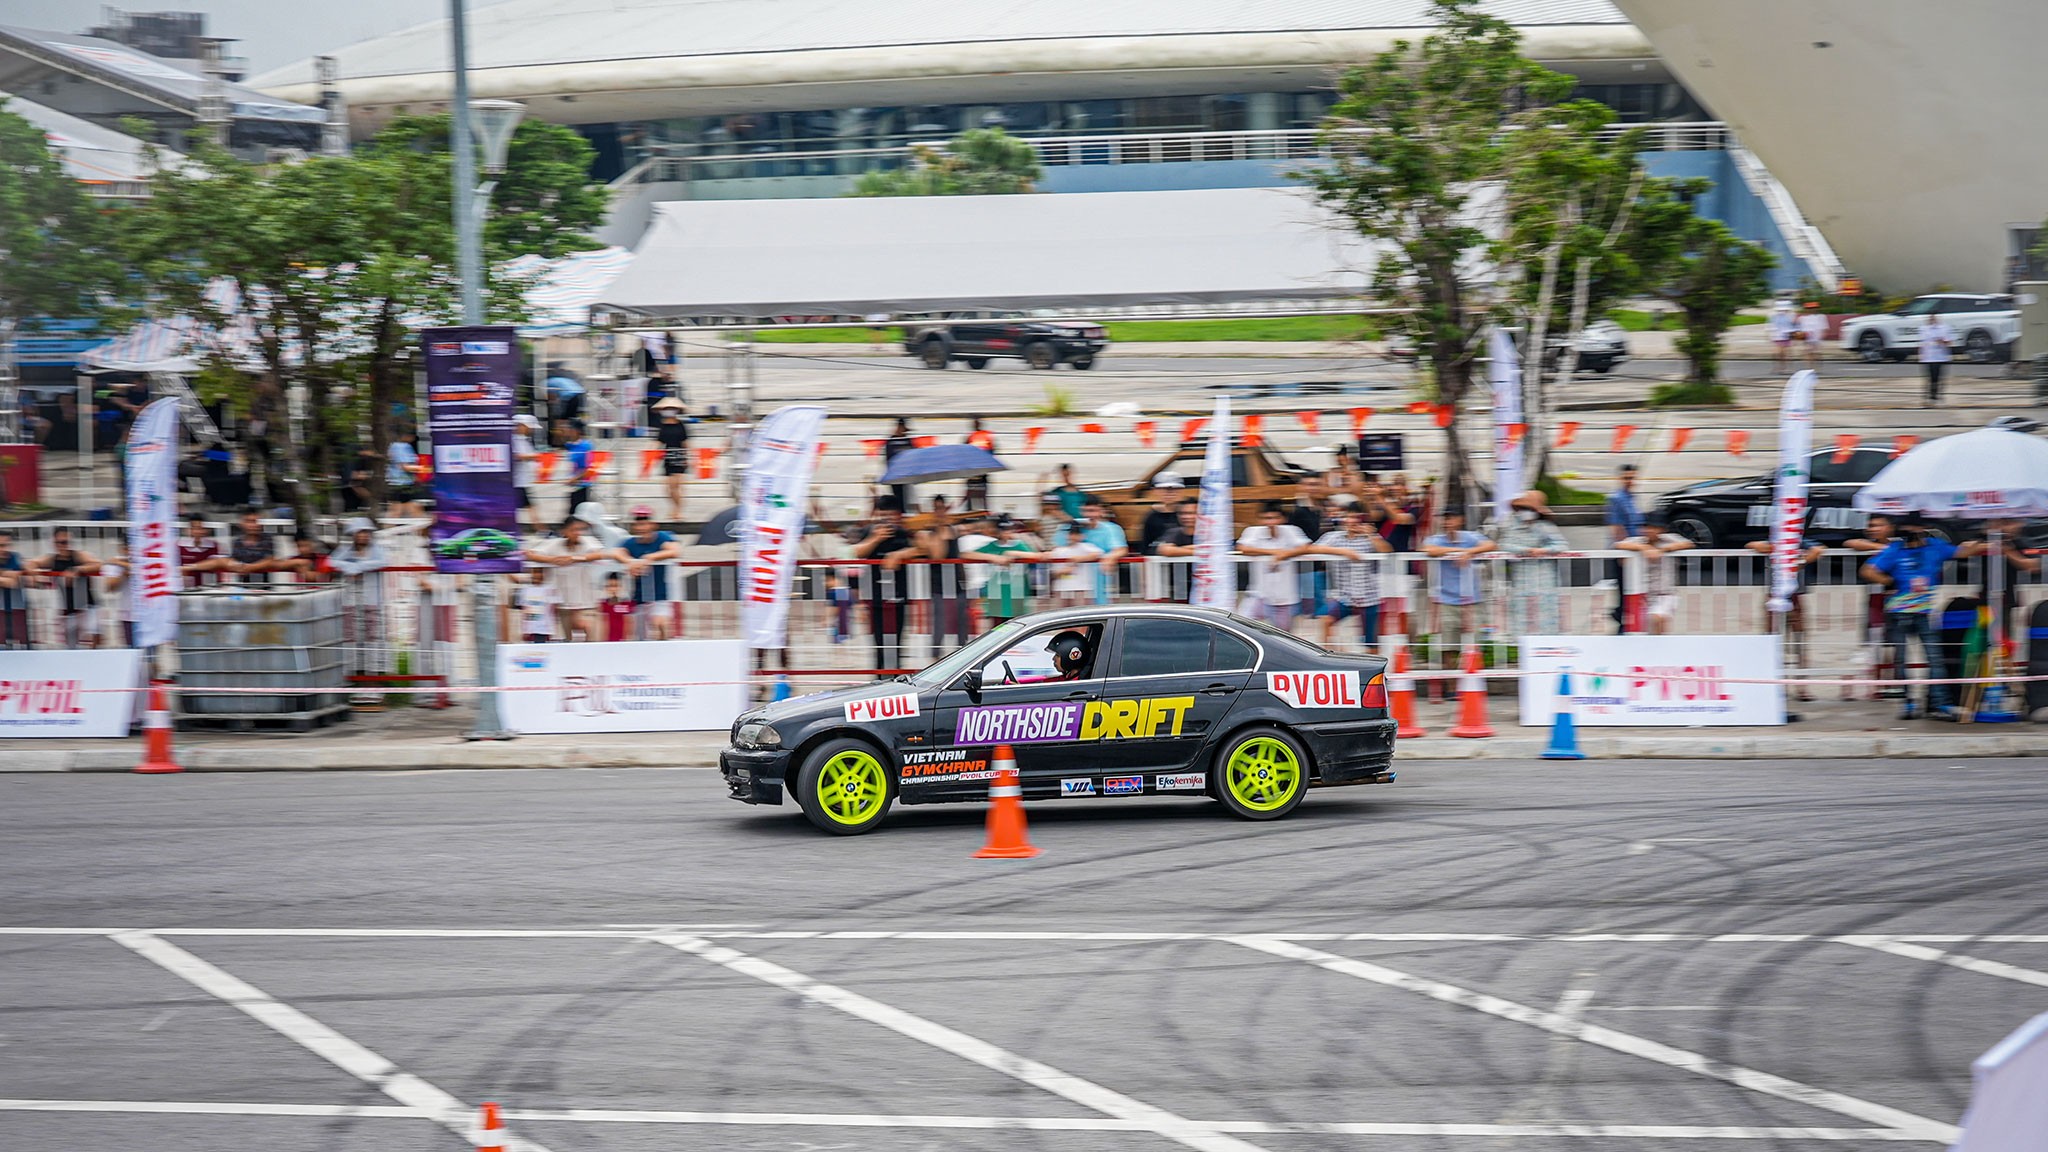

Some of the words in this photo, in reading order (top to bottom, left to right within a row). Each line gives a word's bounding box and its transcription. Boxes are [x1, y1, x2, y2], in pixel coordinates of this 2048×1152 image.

[850, 695, 916, 720] PVOIL
[959, 705, 1077, 742] NORTHSIDE
[1079, 695, 1195, 741] DRIFT
[903, 750, 967, 764] VIETNAM
[901, 760, 987, 777] GYMKHANA
[900, 773, 960, 785] CHAMPIONSHIP
[960, 772, 982, 780] PVOIL
[1158, 776, 1203, 789] Ekokemika
